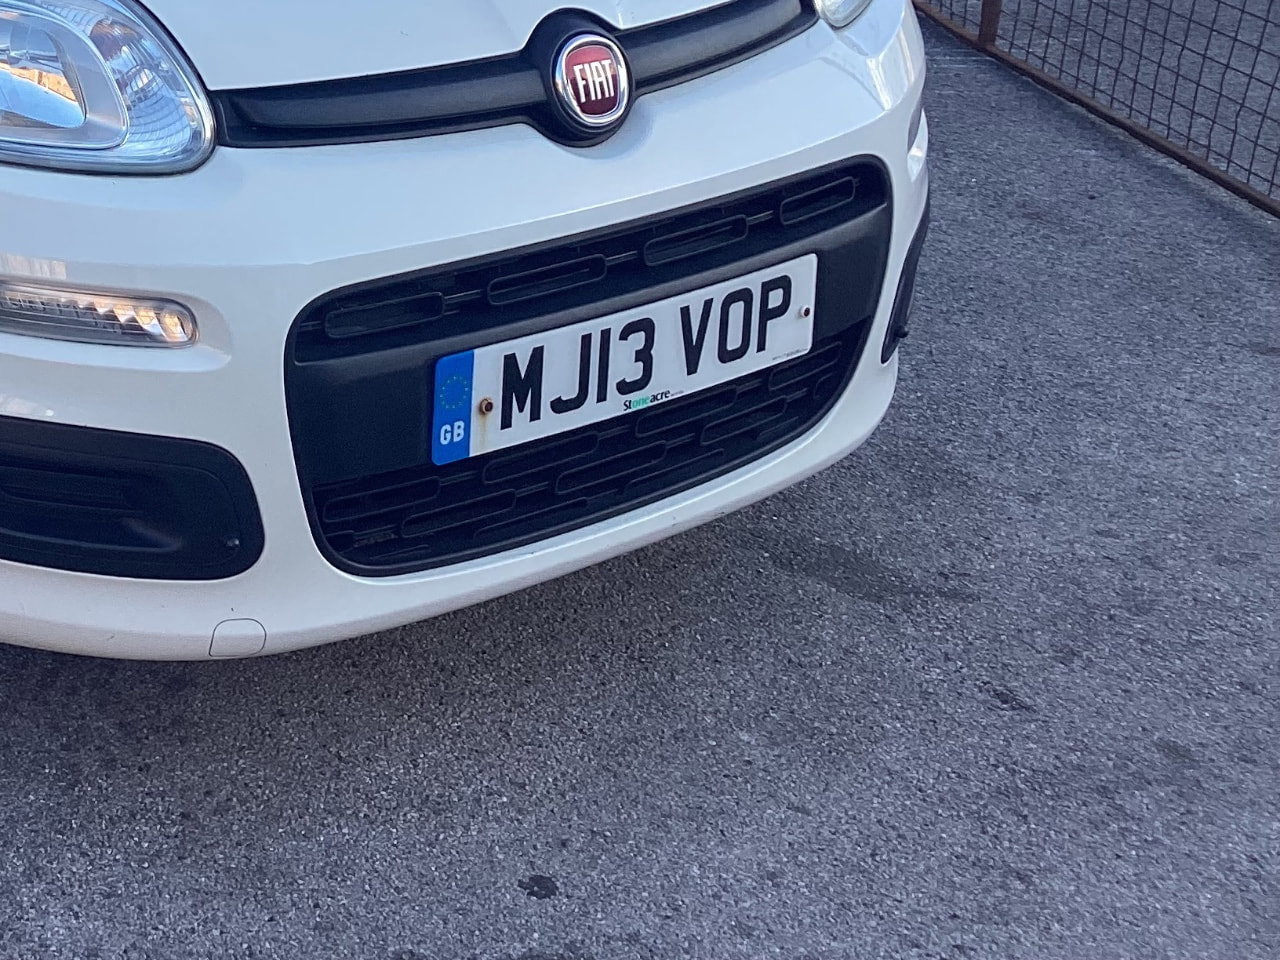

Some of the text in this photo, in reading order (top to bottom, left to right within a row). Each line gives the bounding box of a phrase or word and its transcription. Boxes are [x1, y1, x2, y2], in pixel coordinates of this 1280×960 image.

[573, 58, 615, 104] FIAT
[499, 274, 793, 431] MJ13 VOP
[623, 389, 671, 412] Stoneacre
[439, 420, 465, 446] GB
